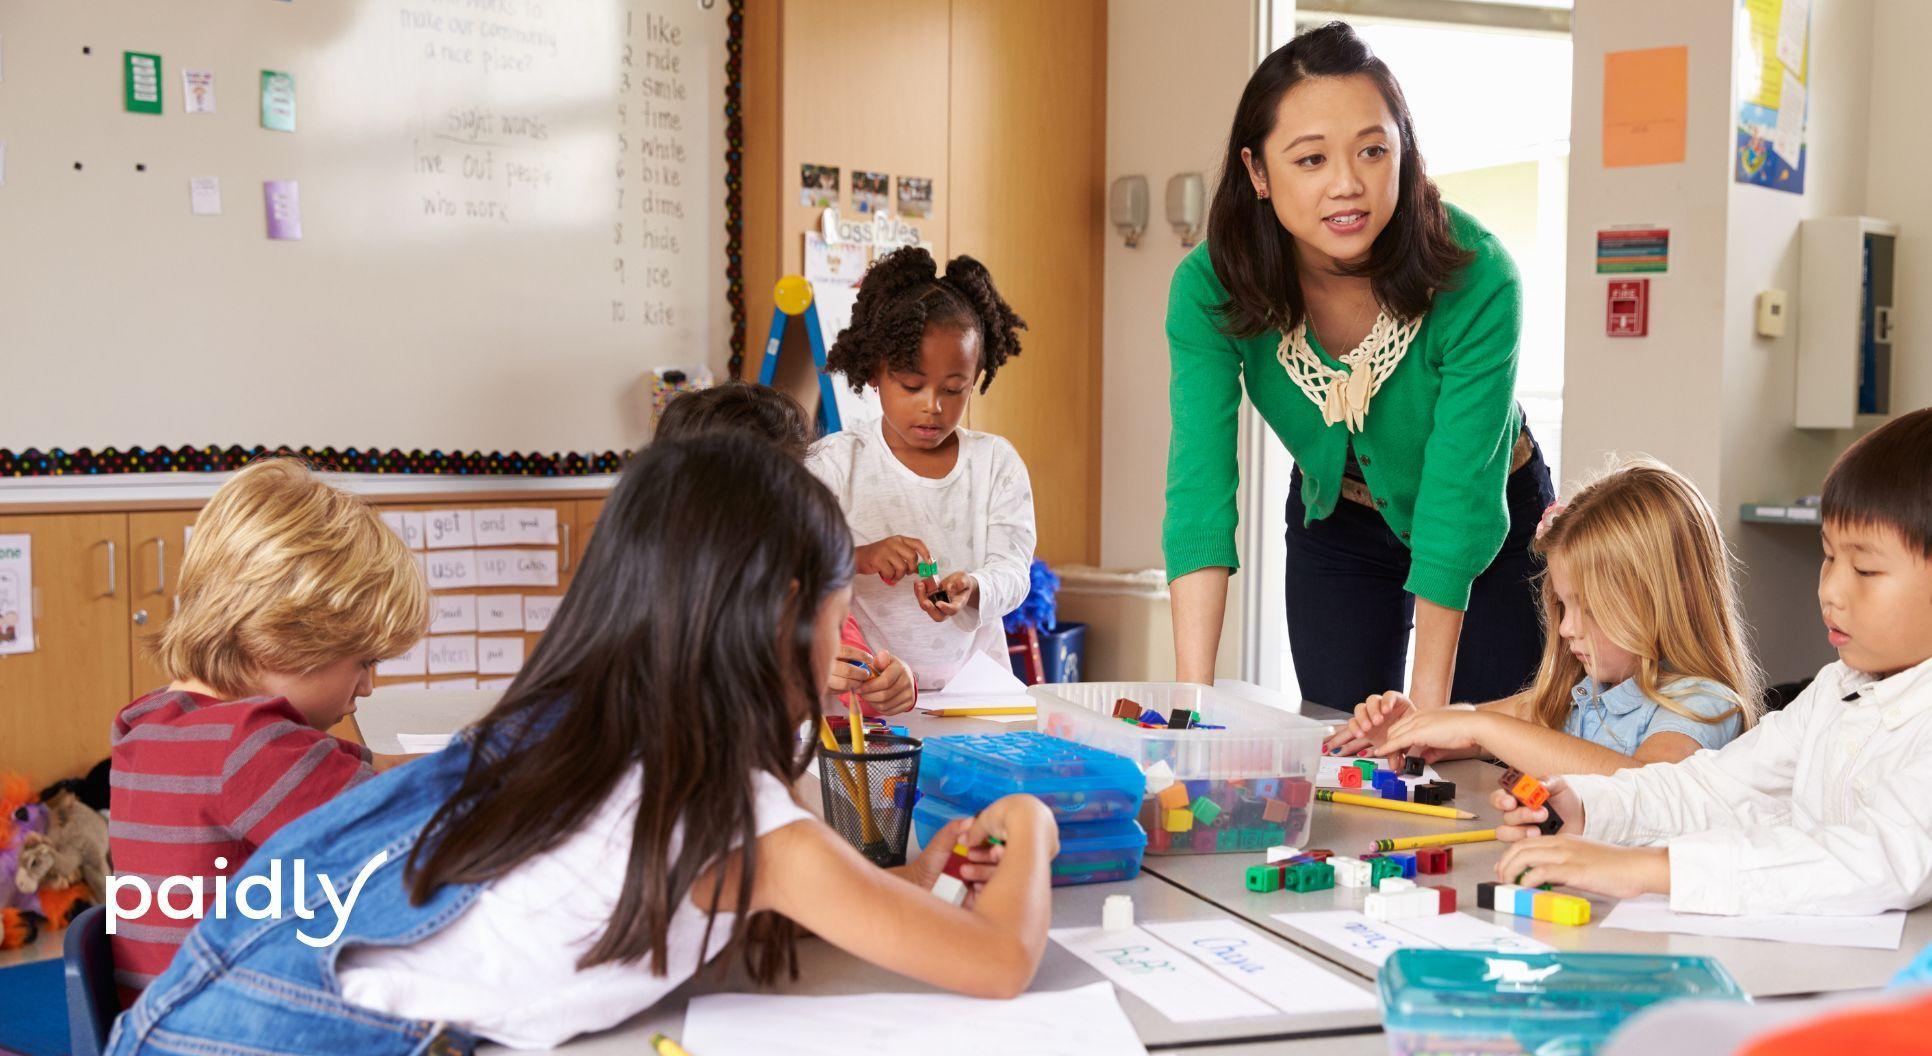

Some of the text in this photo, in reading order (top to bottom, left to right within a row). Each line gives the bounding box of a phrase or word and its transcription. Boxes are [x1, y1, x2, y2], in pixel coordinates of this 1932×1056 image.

[400, 8, 443, 32] make
[646, 12, 682, 47] like
[646, 49, 681, 74] ride
[642, 76, 687, 100] smile
[642, 100, 683, 132] time
[641, 136, 687, 163] white
[642, 156, 682, 188] bike
[641, 188, 685, 219] dime
[642, 218, 681, 254] hide
[1612, 288, 1636, 298] FIRE
[643, 300, 676, 328] kite
[433, 513, 460, 540] get
[480, 515, 506, 532] and
[431, 561, 466, 579] use
[485, 558, 507, 575] up
